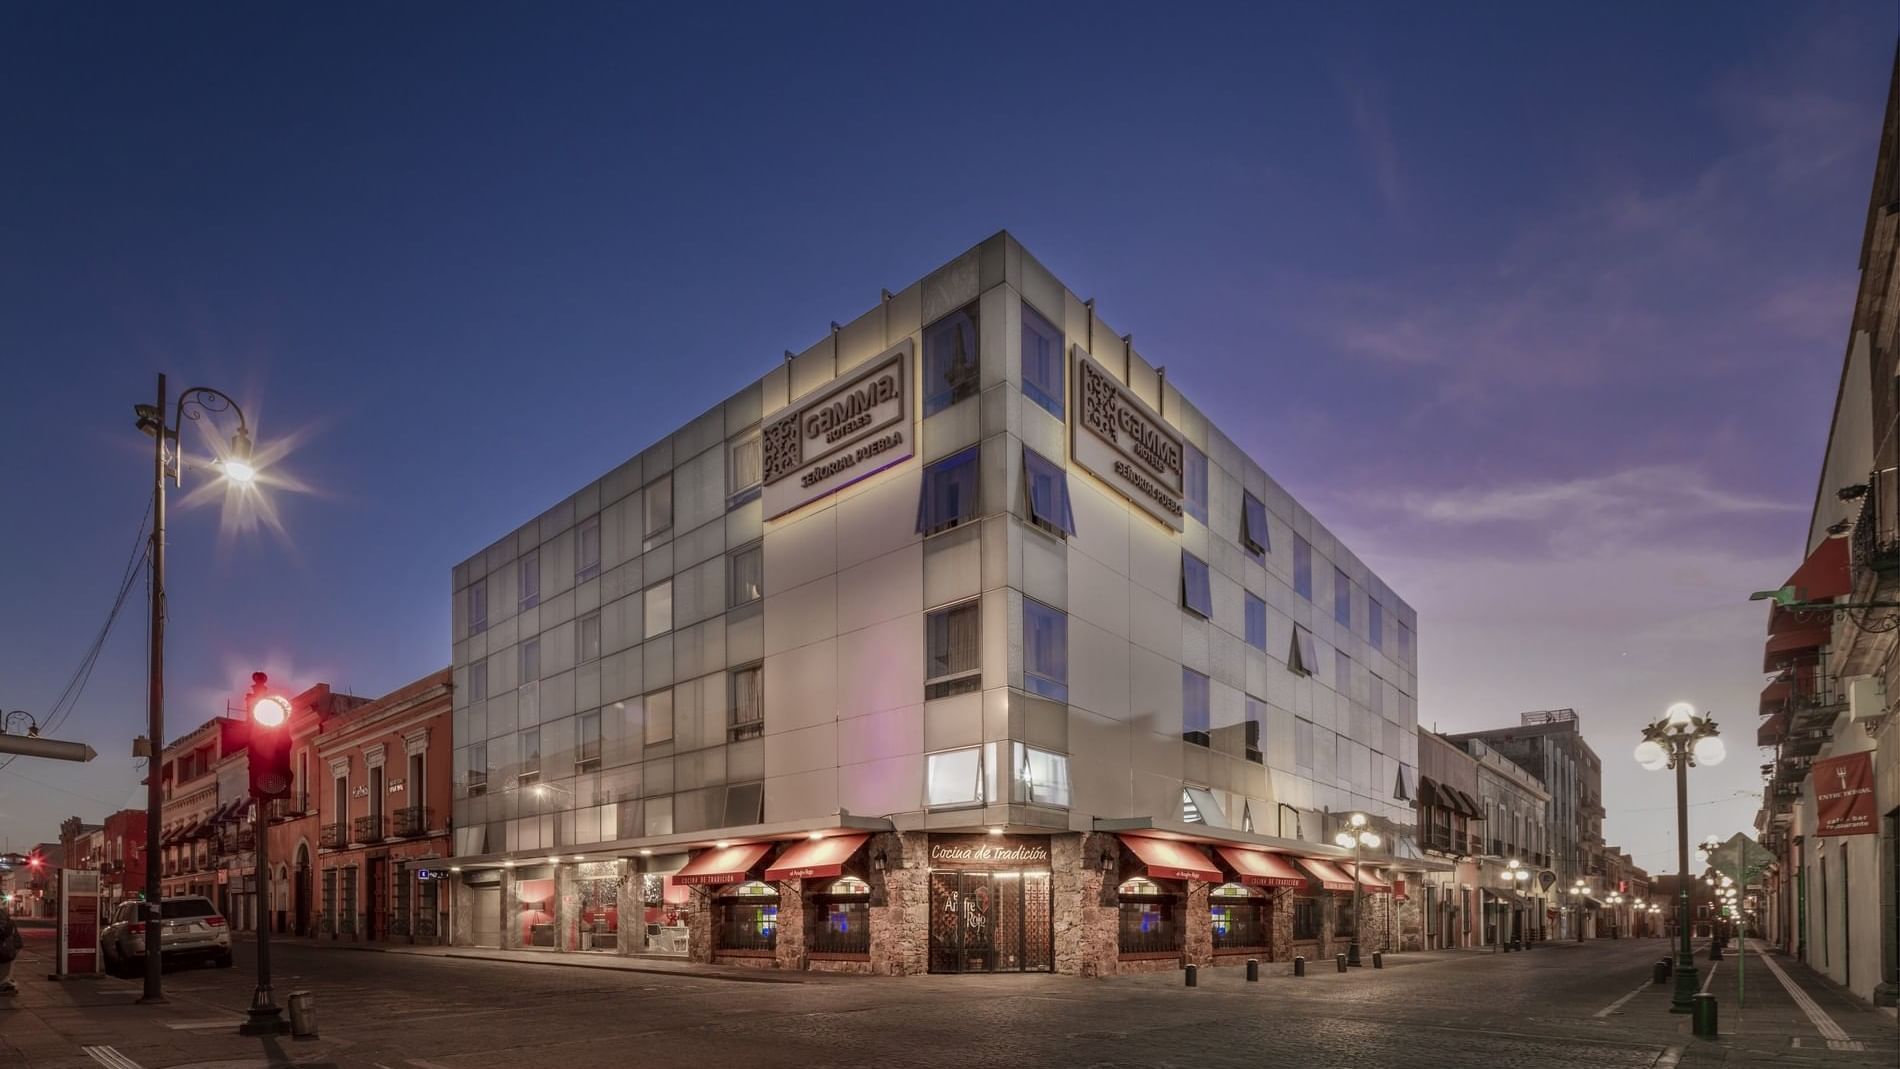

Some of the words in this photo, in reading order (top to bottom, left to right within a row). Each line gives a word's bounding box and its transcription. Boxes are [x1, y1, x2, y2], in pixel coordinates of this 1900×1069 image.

[826, 413, 872, 444] HOTELES
[800, 454, 856, 488] SEÑORIAL
[856, 431, 903, 462] PUEBLA
[1134, 441, 1166, 473] HOTELES
[931, 844, 971, 859] Cocina
[974, 844, 991, 859] de
[994, 844, 1047, 860] Tradición
[966, 911, 987, 934] Rojo
